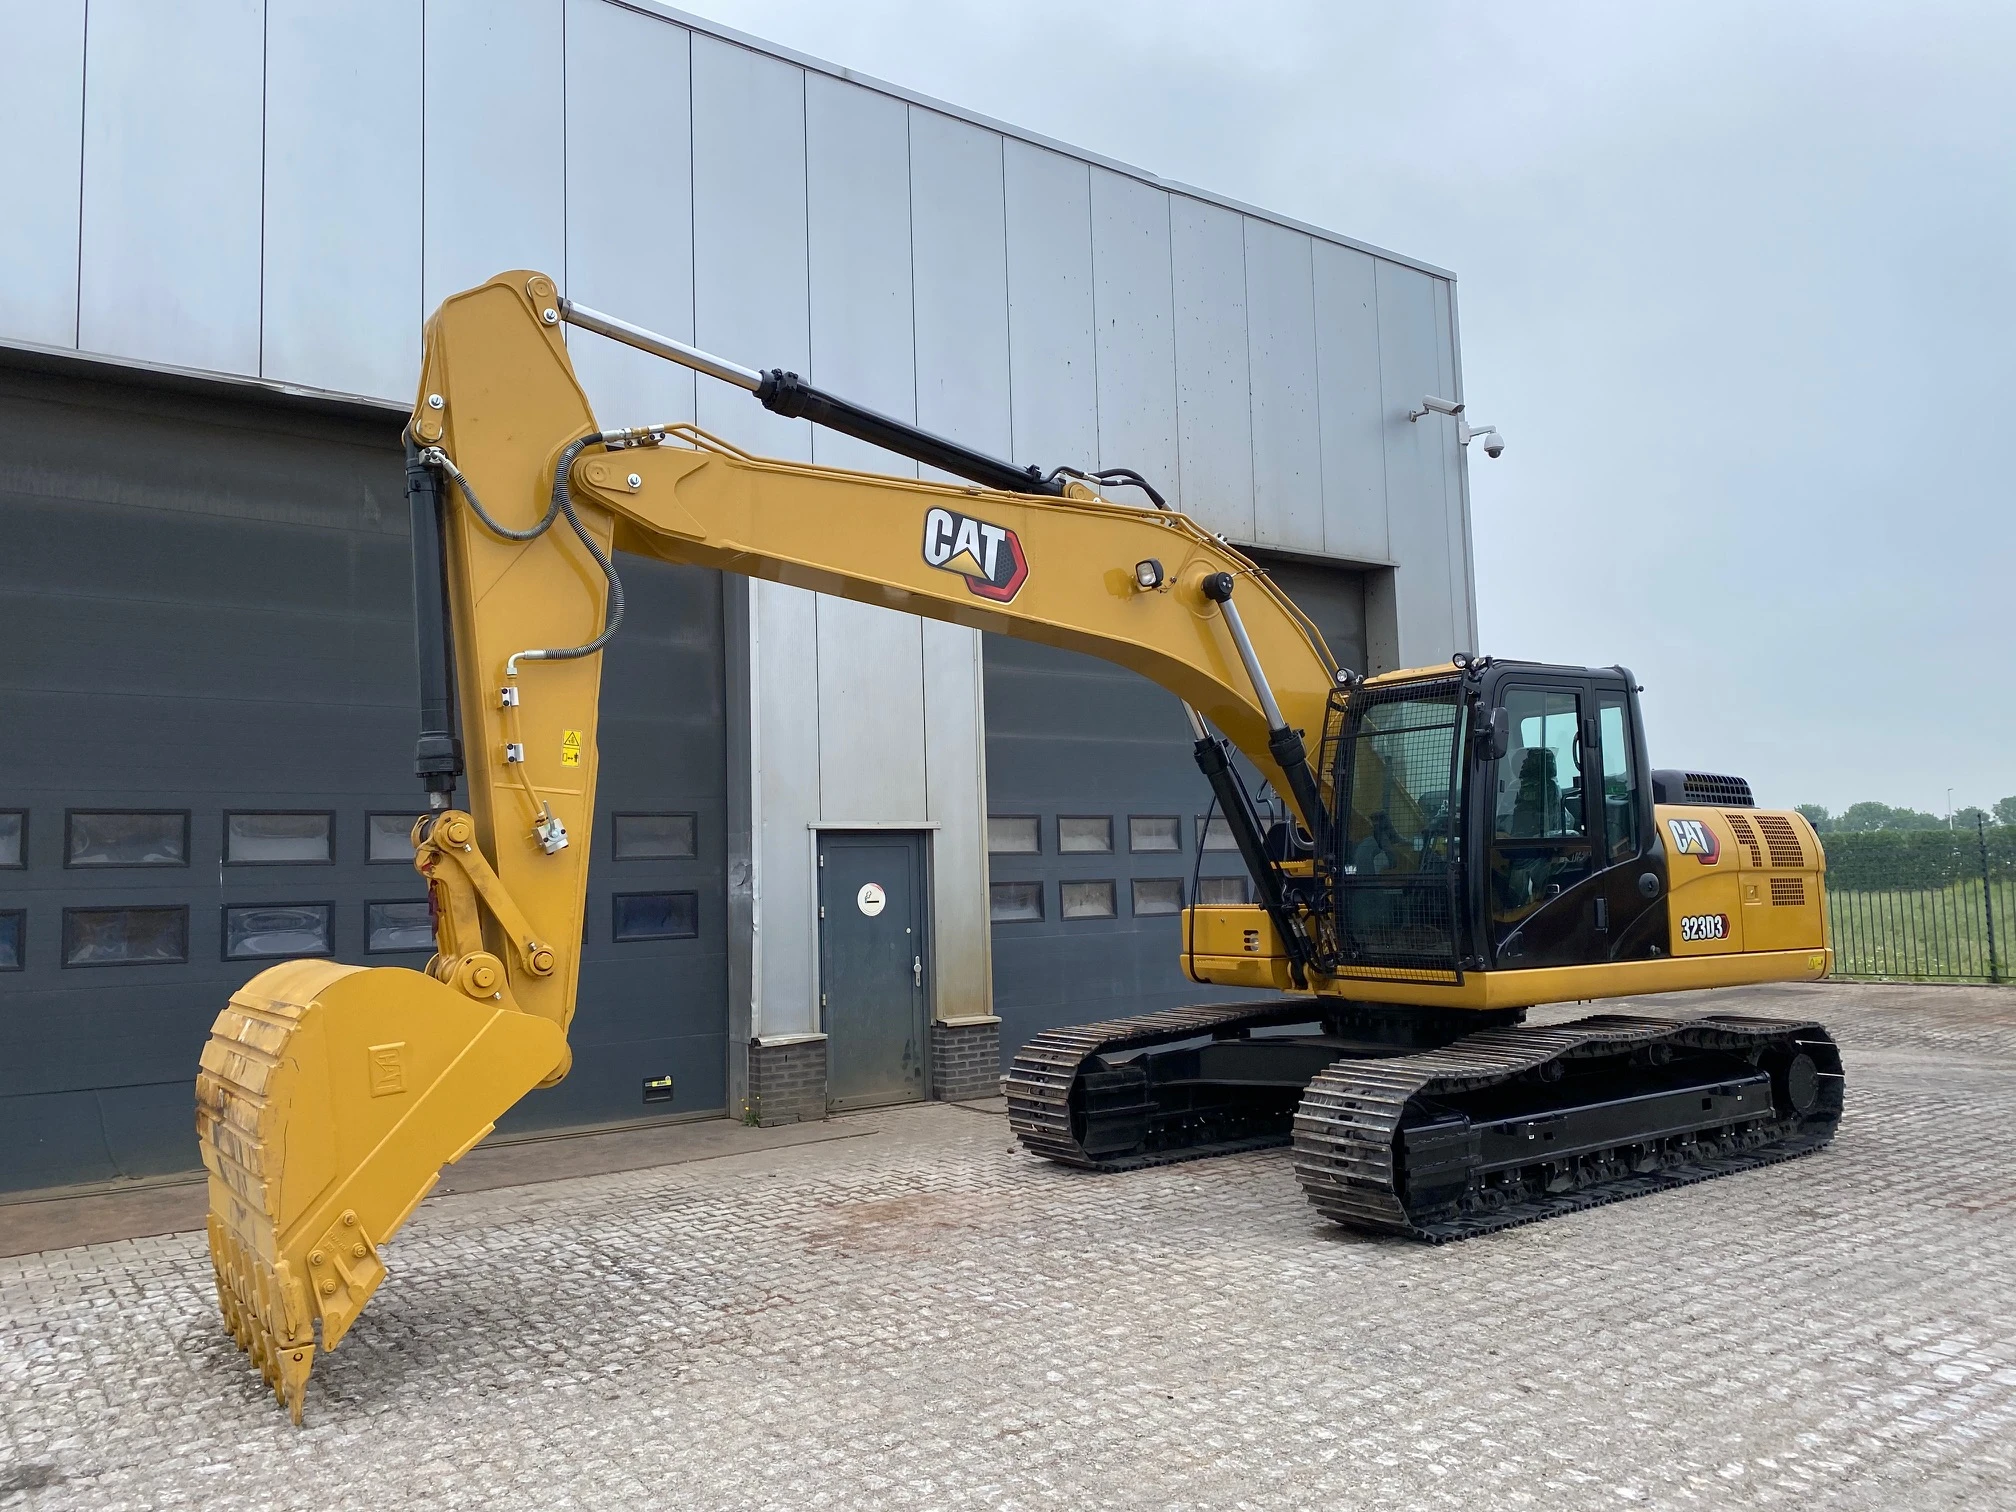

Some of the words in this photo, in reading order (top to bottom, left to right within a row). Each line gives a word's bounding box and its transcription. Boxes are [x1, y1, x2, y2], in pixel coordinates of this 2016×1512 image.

[924, 508, 1006, 582] CAT
[1668, 820, 1710, 854] CAT
[1681, 915, 1723, 941] 323D3
[374, 1049, 402, 1089] CAT
